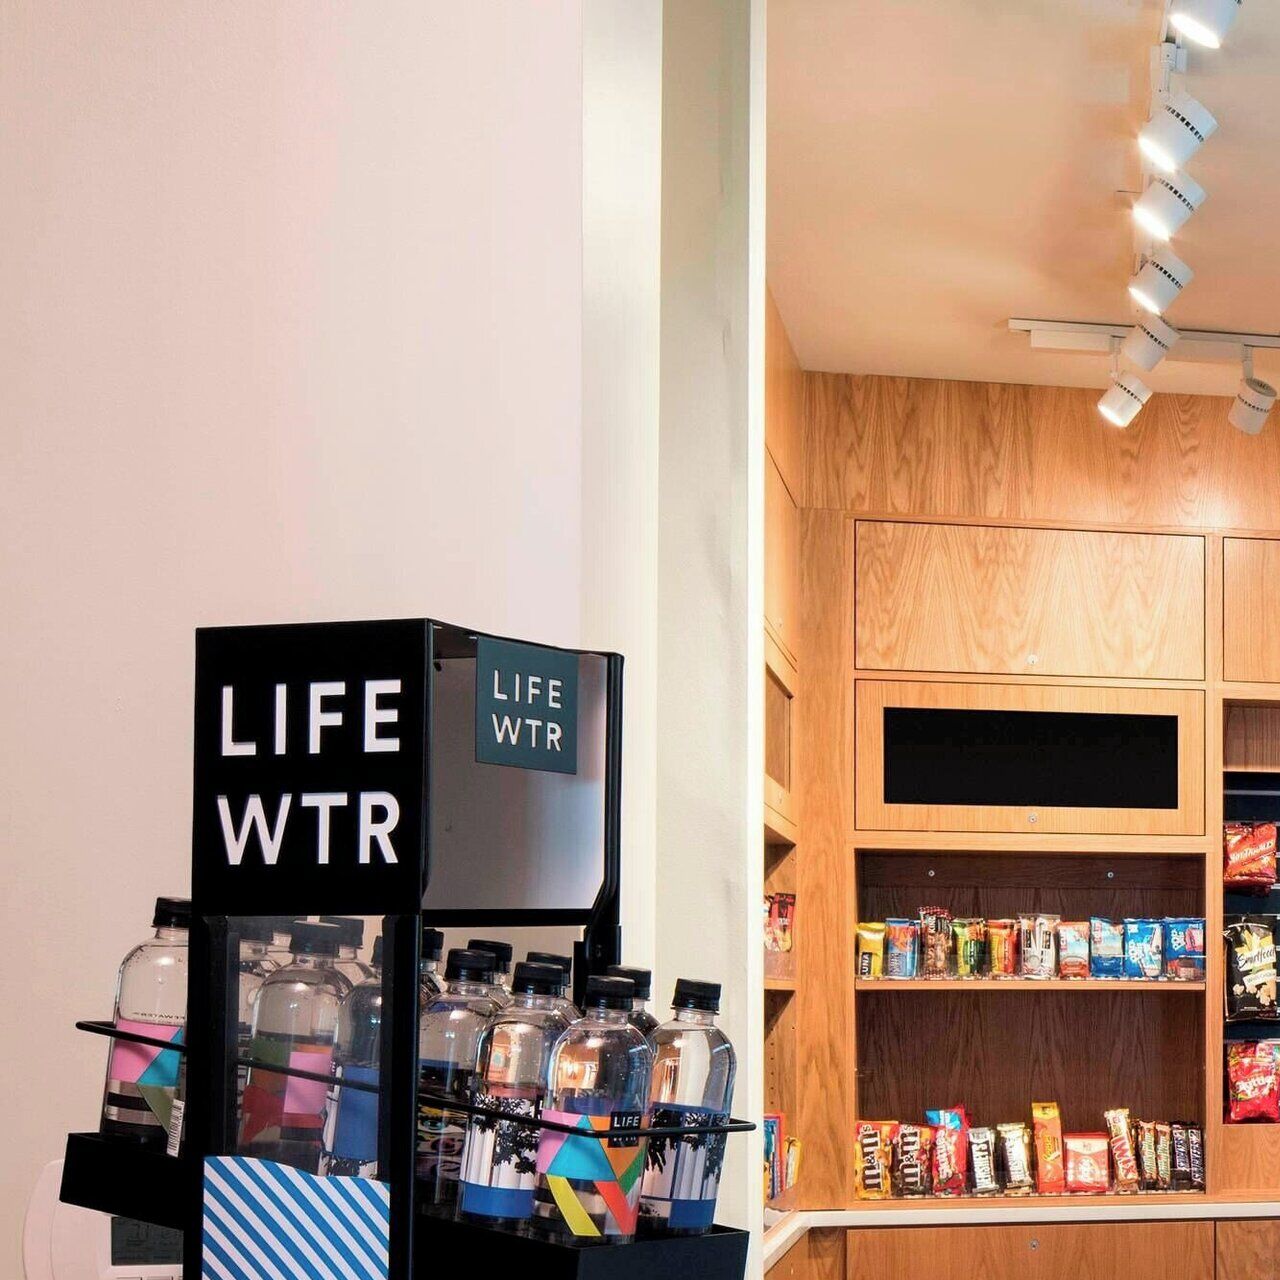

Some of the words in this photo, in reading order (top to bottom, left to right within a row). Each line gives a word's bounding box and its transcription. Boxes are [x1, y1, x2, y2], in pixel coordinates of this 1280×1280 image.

[221, 679, 402, 756] LIFE
[493, 670, 563, 709] LIFE
[491, 713, 563, 752] WTR
[216, 790, 400, 866] WTR
[613, 1115, 640, 1128] LIFE
[859, 1124, 882, 1190] m&m's
[898, 1124, 921, 1191] m&m's
